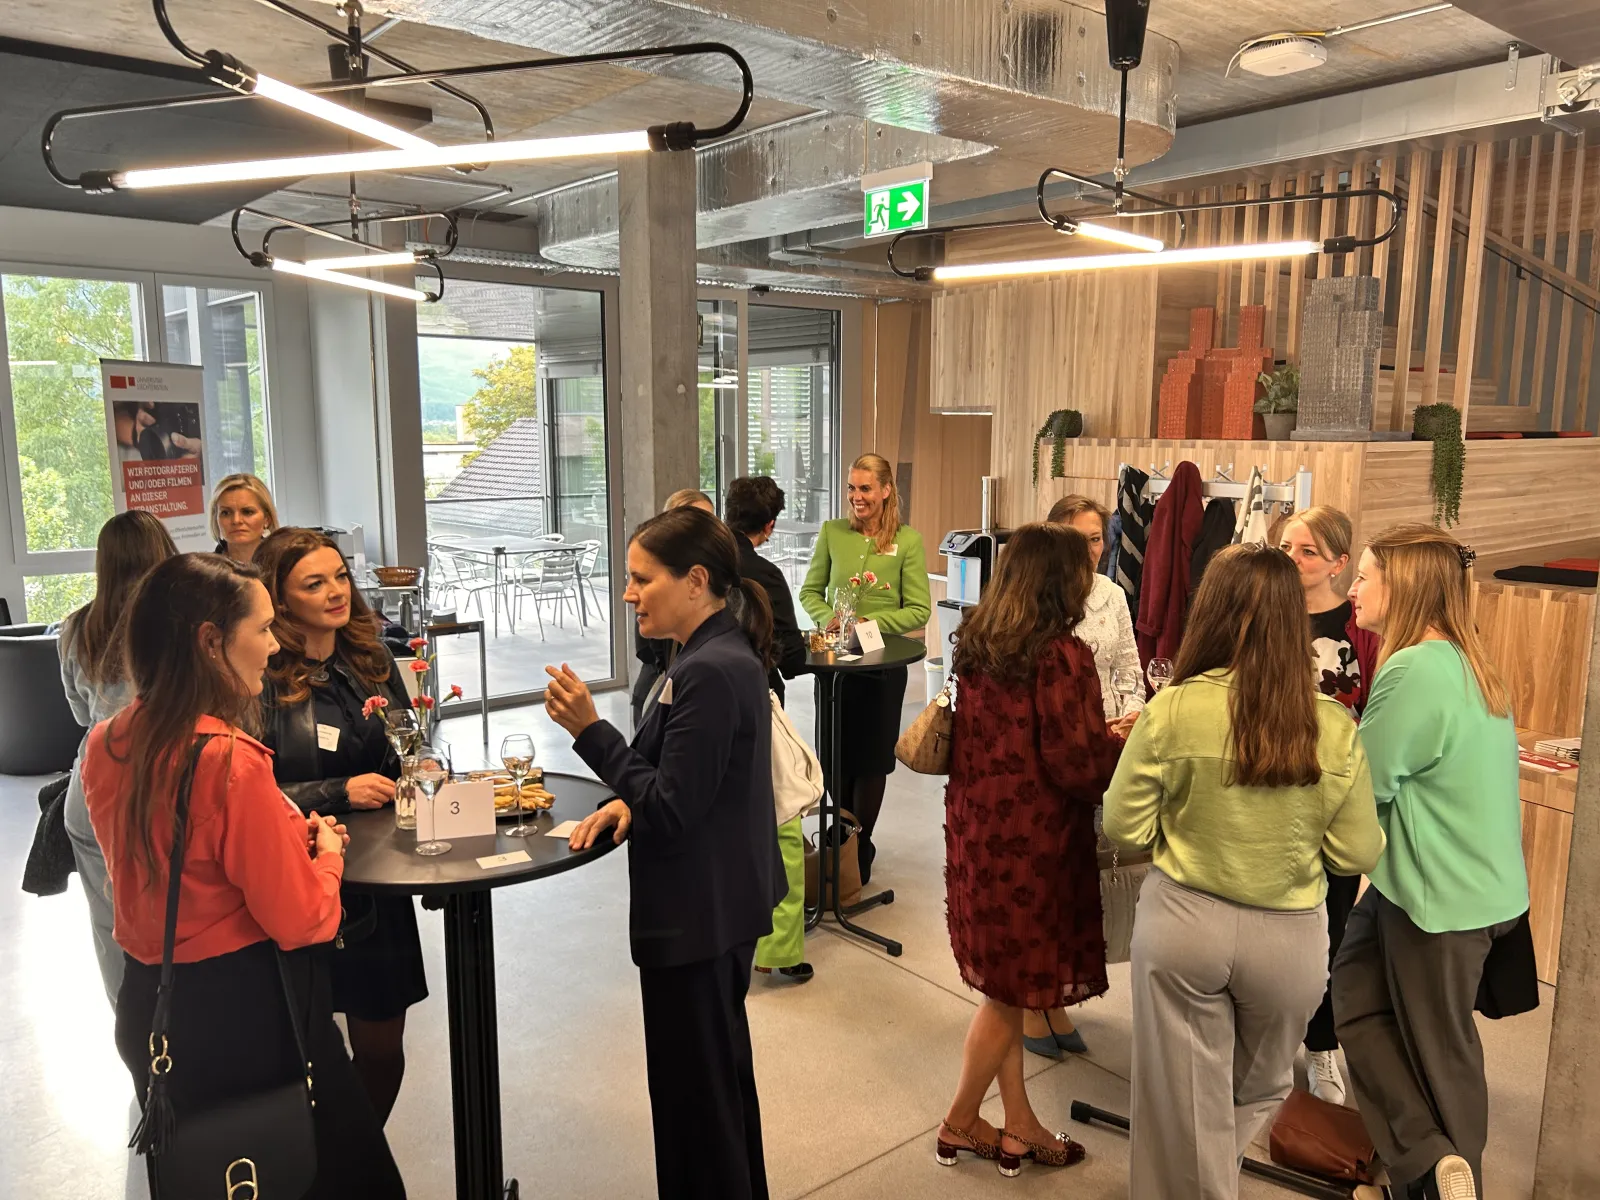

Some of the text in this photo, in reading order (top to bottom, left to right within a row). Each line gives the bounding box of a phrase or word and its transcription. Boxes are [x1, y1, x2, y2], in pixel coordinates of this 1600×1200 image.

[127, 464, 198, 477] WIR FOTOGRAFIEREN
[167, 477, 192, 487] FILMEN
[130, 490, 168, 503] AN DIESER
[450, 801, 460, 815] 3
